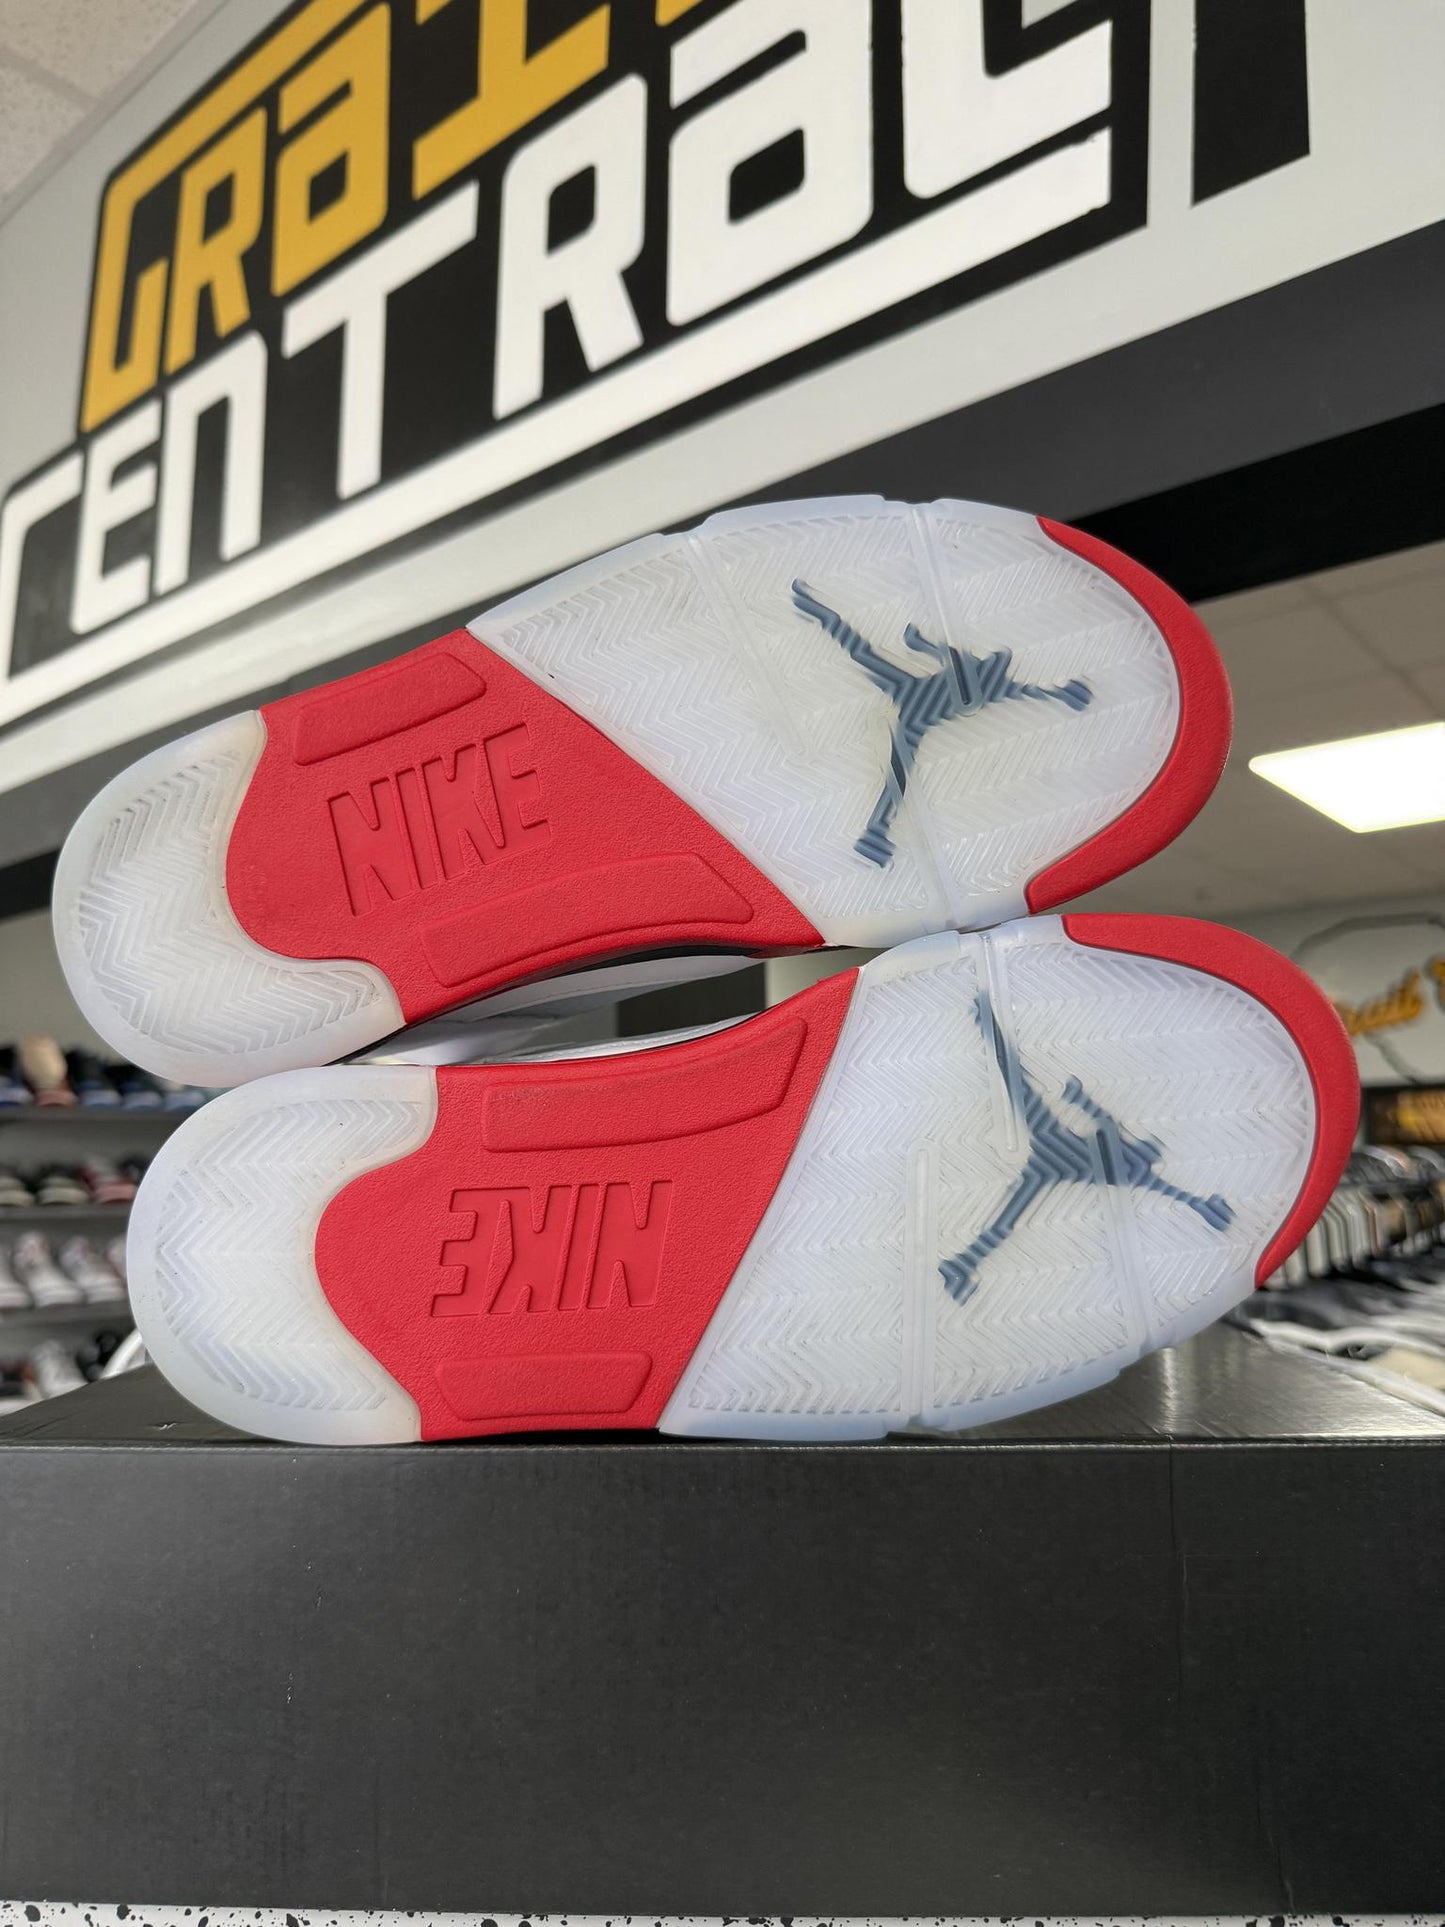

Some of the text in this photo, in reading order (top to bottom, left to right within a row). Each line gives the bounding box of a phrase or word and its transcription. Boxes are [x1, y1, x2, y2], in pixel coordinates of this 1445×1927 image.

[80, 0, 698, 434] GRAI
[327, 722, 552, 917] NIKE
[430, 1179, 673, 1317] NIKE
